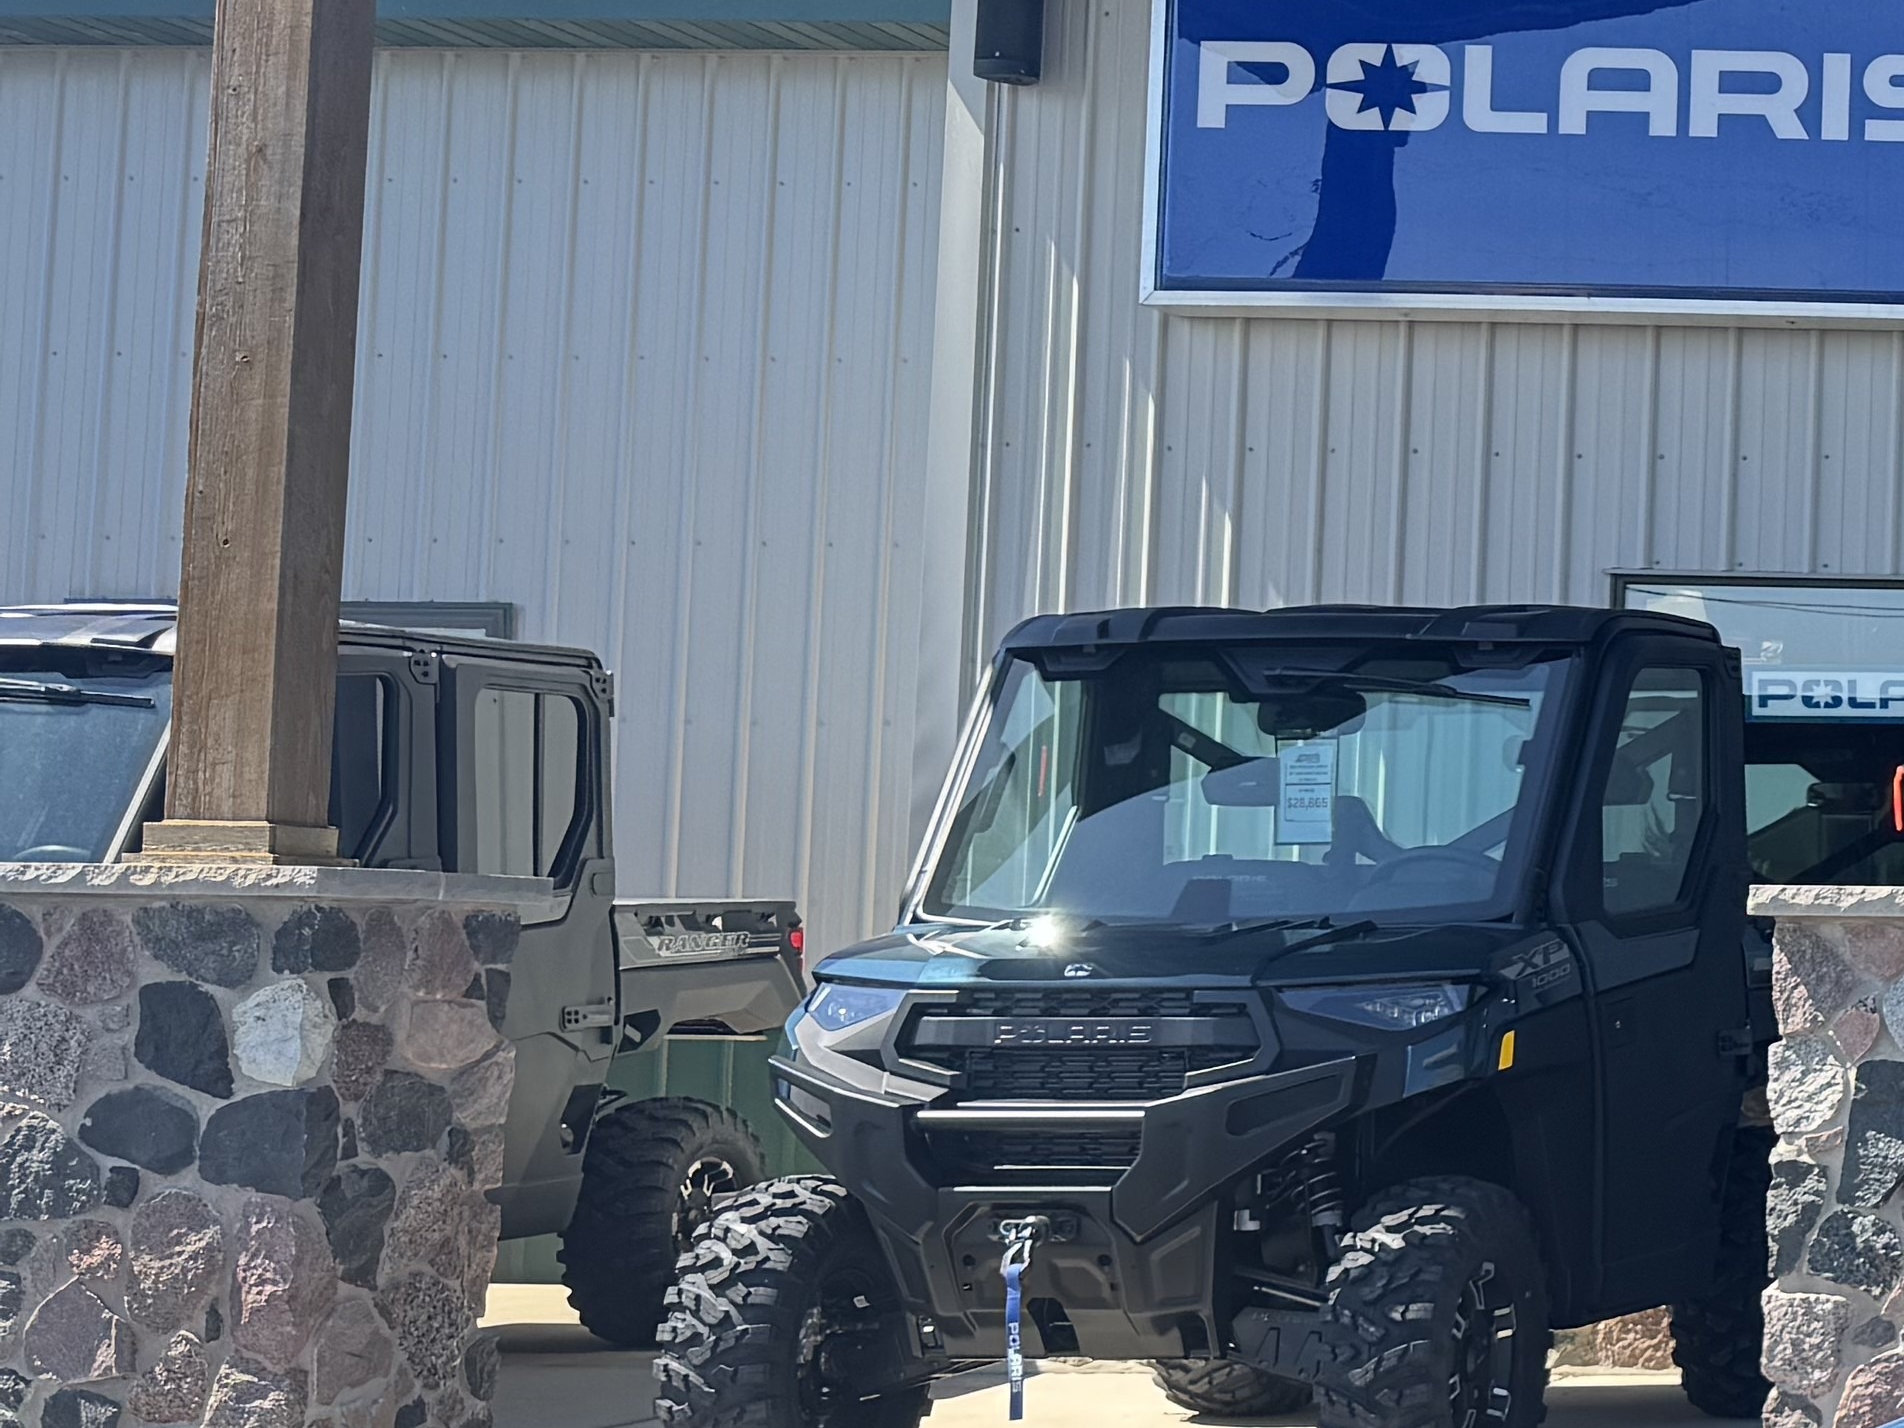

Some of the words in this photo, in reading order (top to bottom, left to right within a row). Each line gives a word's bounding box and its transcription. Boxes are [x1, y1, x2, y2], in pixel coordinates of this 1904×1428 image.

[657, 931, 750, 953] RANGER
[1512, 938, 1566, 978] XP
[1532, 963, 1570, 988] 1000
[994, 1026, 1152, 1044] POLARIS
[1007, 1322, 1022, 1392] POLARIS
